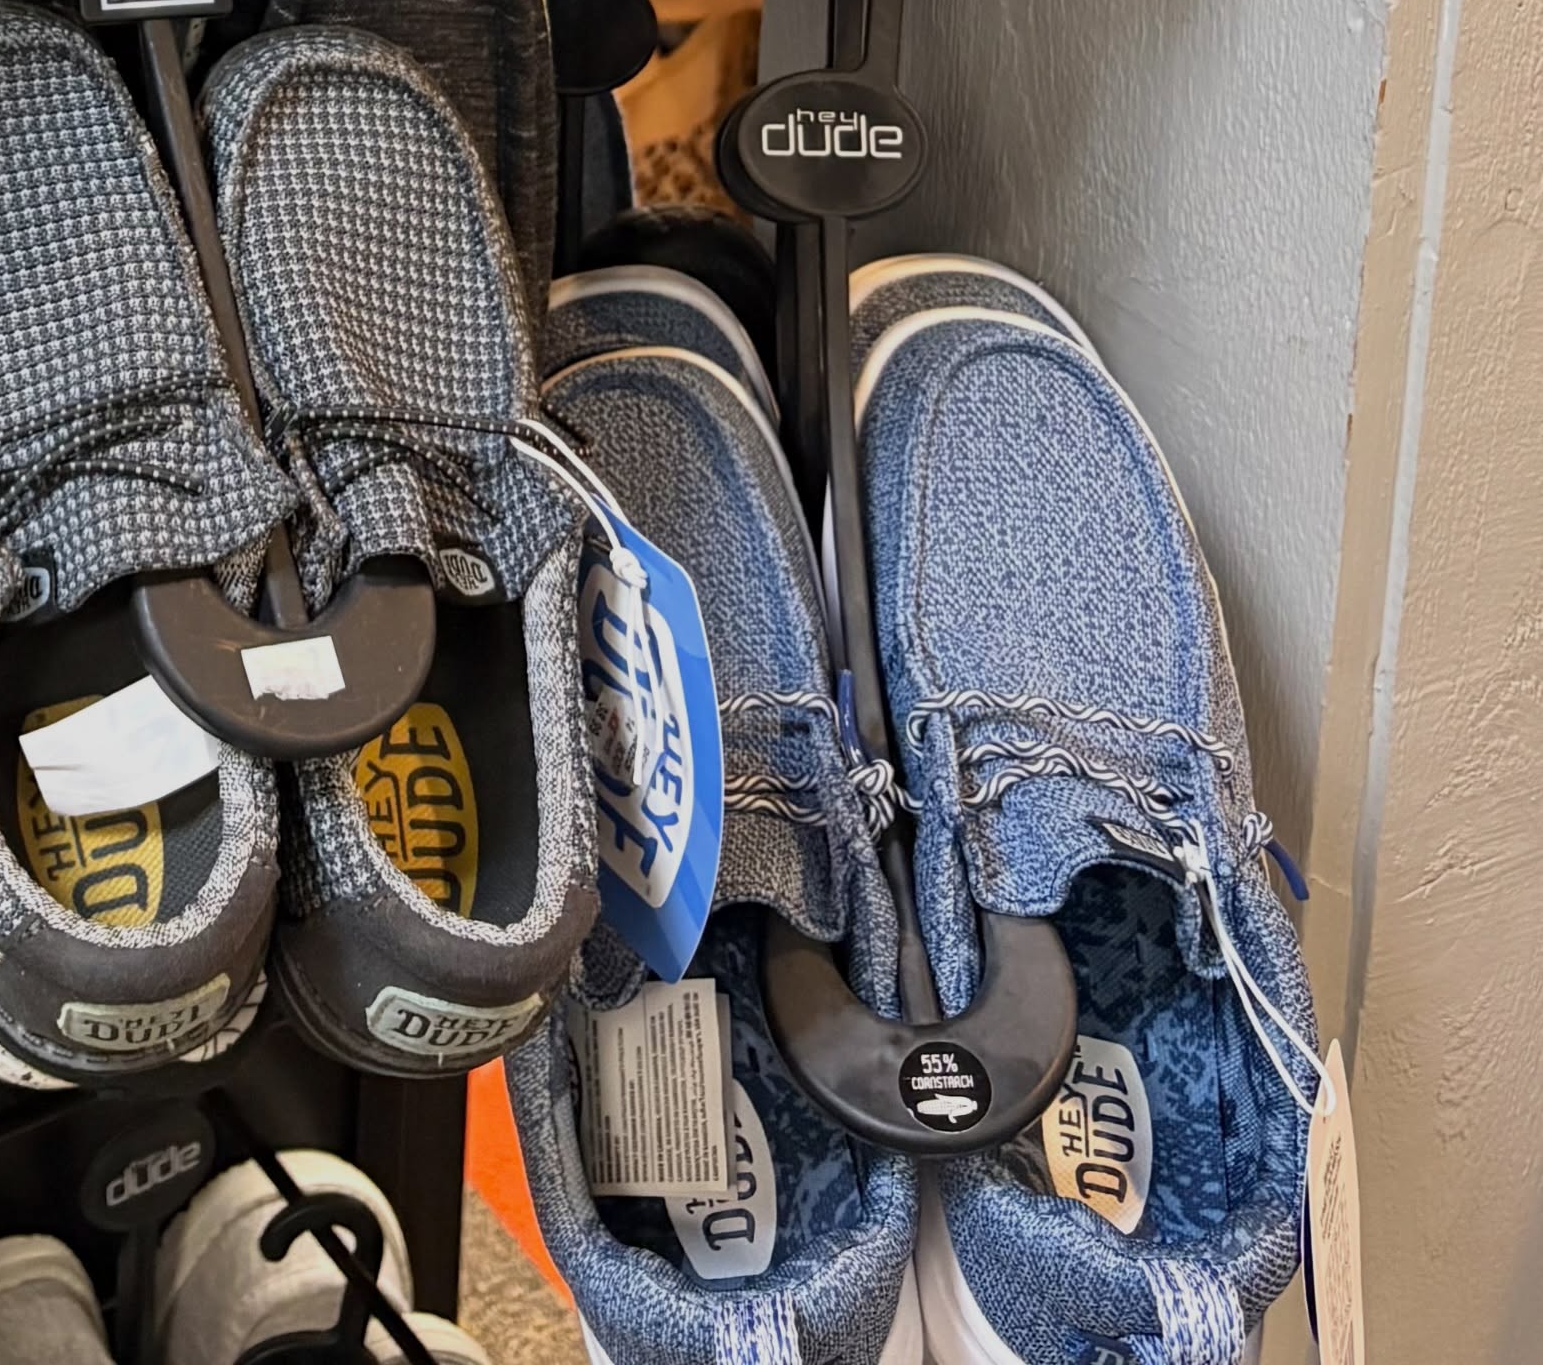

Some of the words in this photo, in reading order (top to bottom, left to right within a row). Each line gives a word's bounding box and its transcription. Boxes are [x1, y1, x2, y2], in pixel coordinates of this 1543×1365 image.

[761, 113, 904, 159] dude
[795, 107, 859, 131] hey
[364, 765, 400, 861] HEY
[379, 720, 469, 909] DUDE
[642, 712, 685, 853] HEY
[71, 810, 150, 919] DU
[392, 1008, 517, 1047] DUDE
[920, 1052, 960, 1075] 55%
[910, 1073, 975, 1091] CORNSTARCH
[1059, 1081, 1090, 1160] HEY
[1073, 1063, 1130, 1205] DUDE
[105, 1141, 202, 1207] dude
